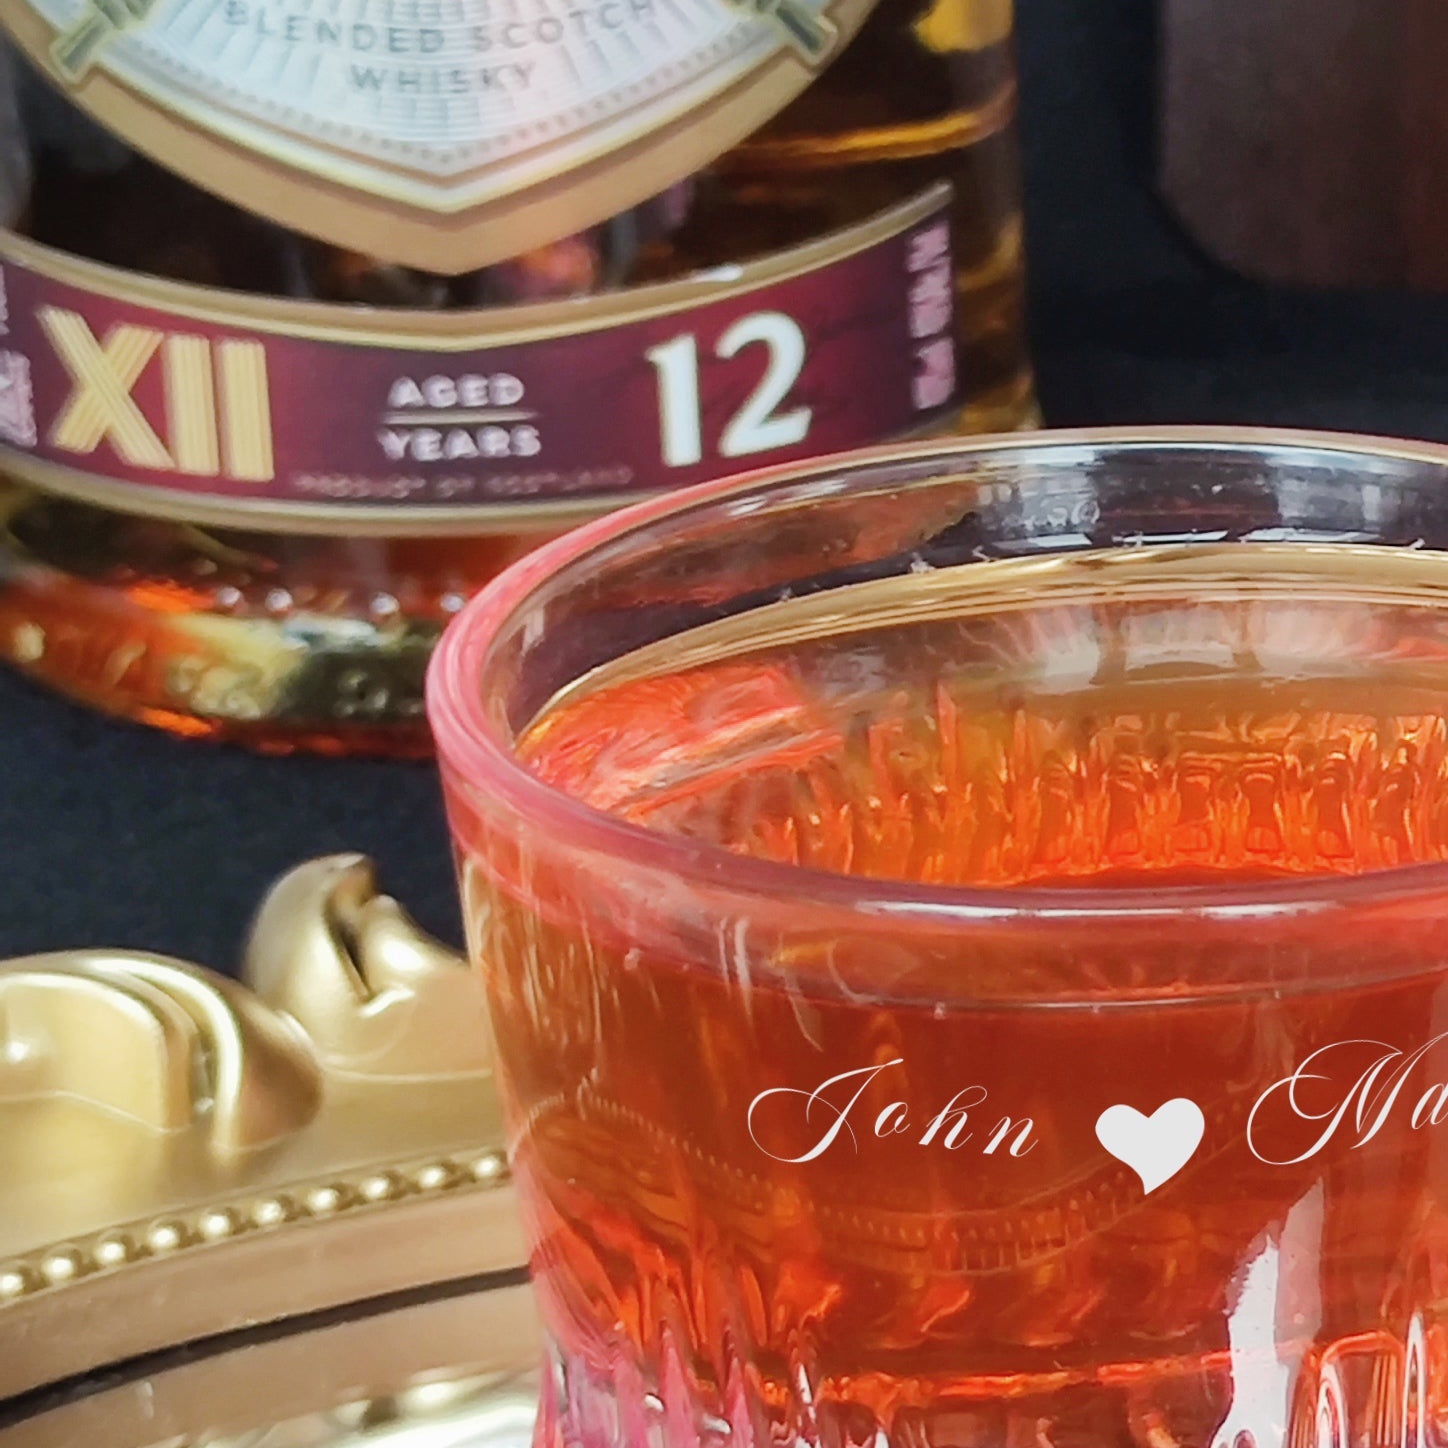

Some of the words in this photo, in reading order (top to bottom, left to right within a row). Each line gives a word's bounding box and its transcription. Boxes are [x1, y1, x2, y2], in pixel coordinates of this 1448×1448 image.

[349, 62, 537, 93] WHISKY
[38, 306, 276, 482] XII
[386, 372, 525, 409] AGED
[645, 310, 813, 467] 12
[376, 424, 542, 462] YEARS
[747, 1057, 1038, 1163] John
